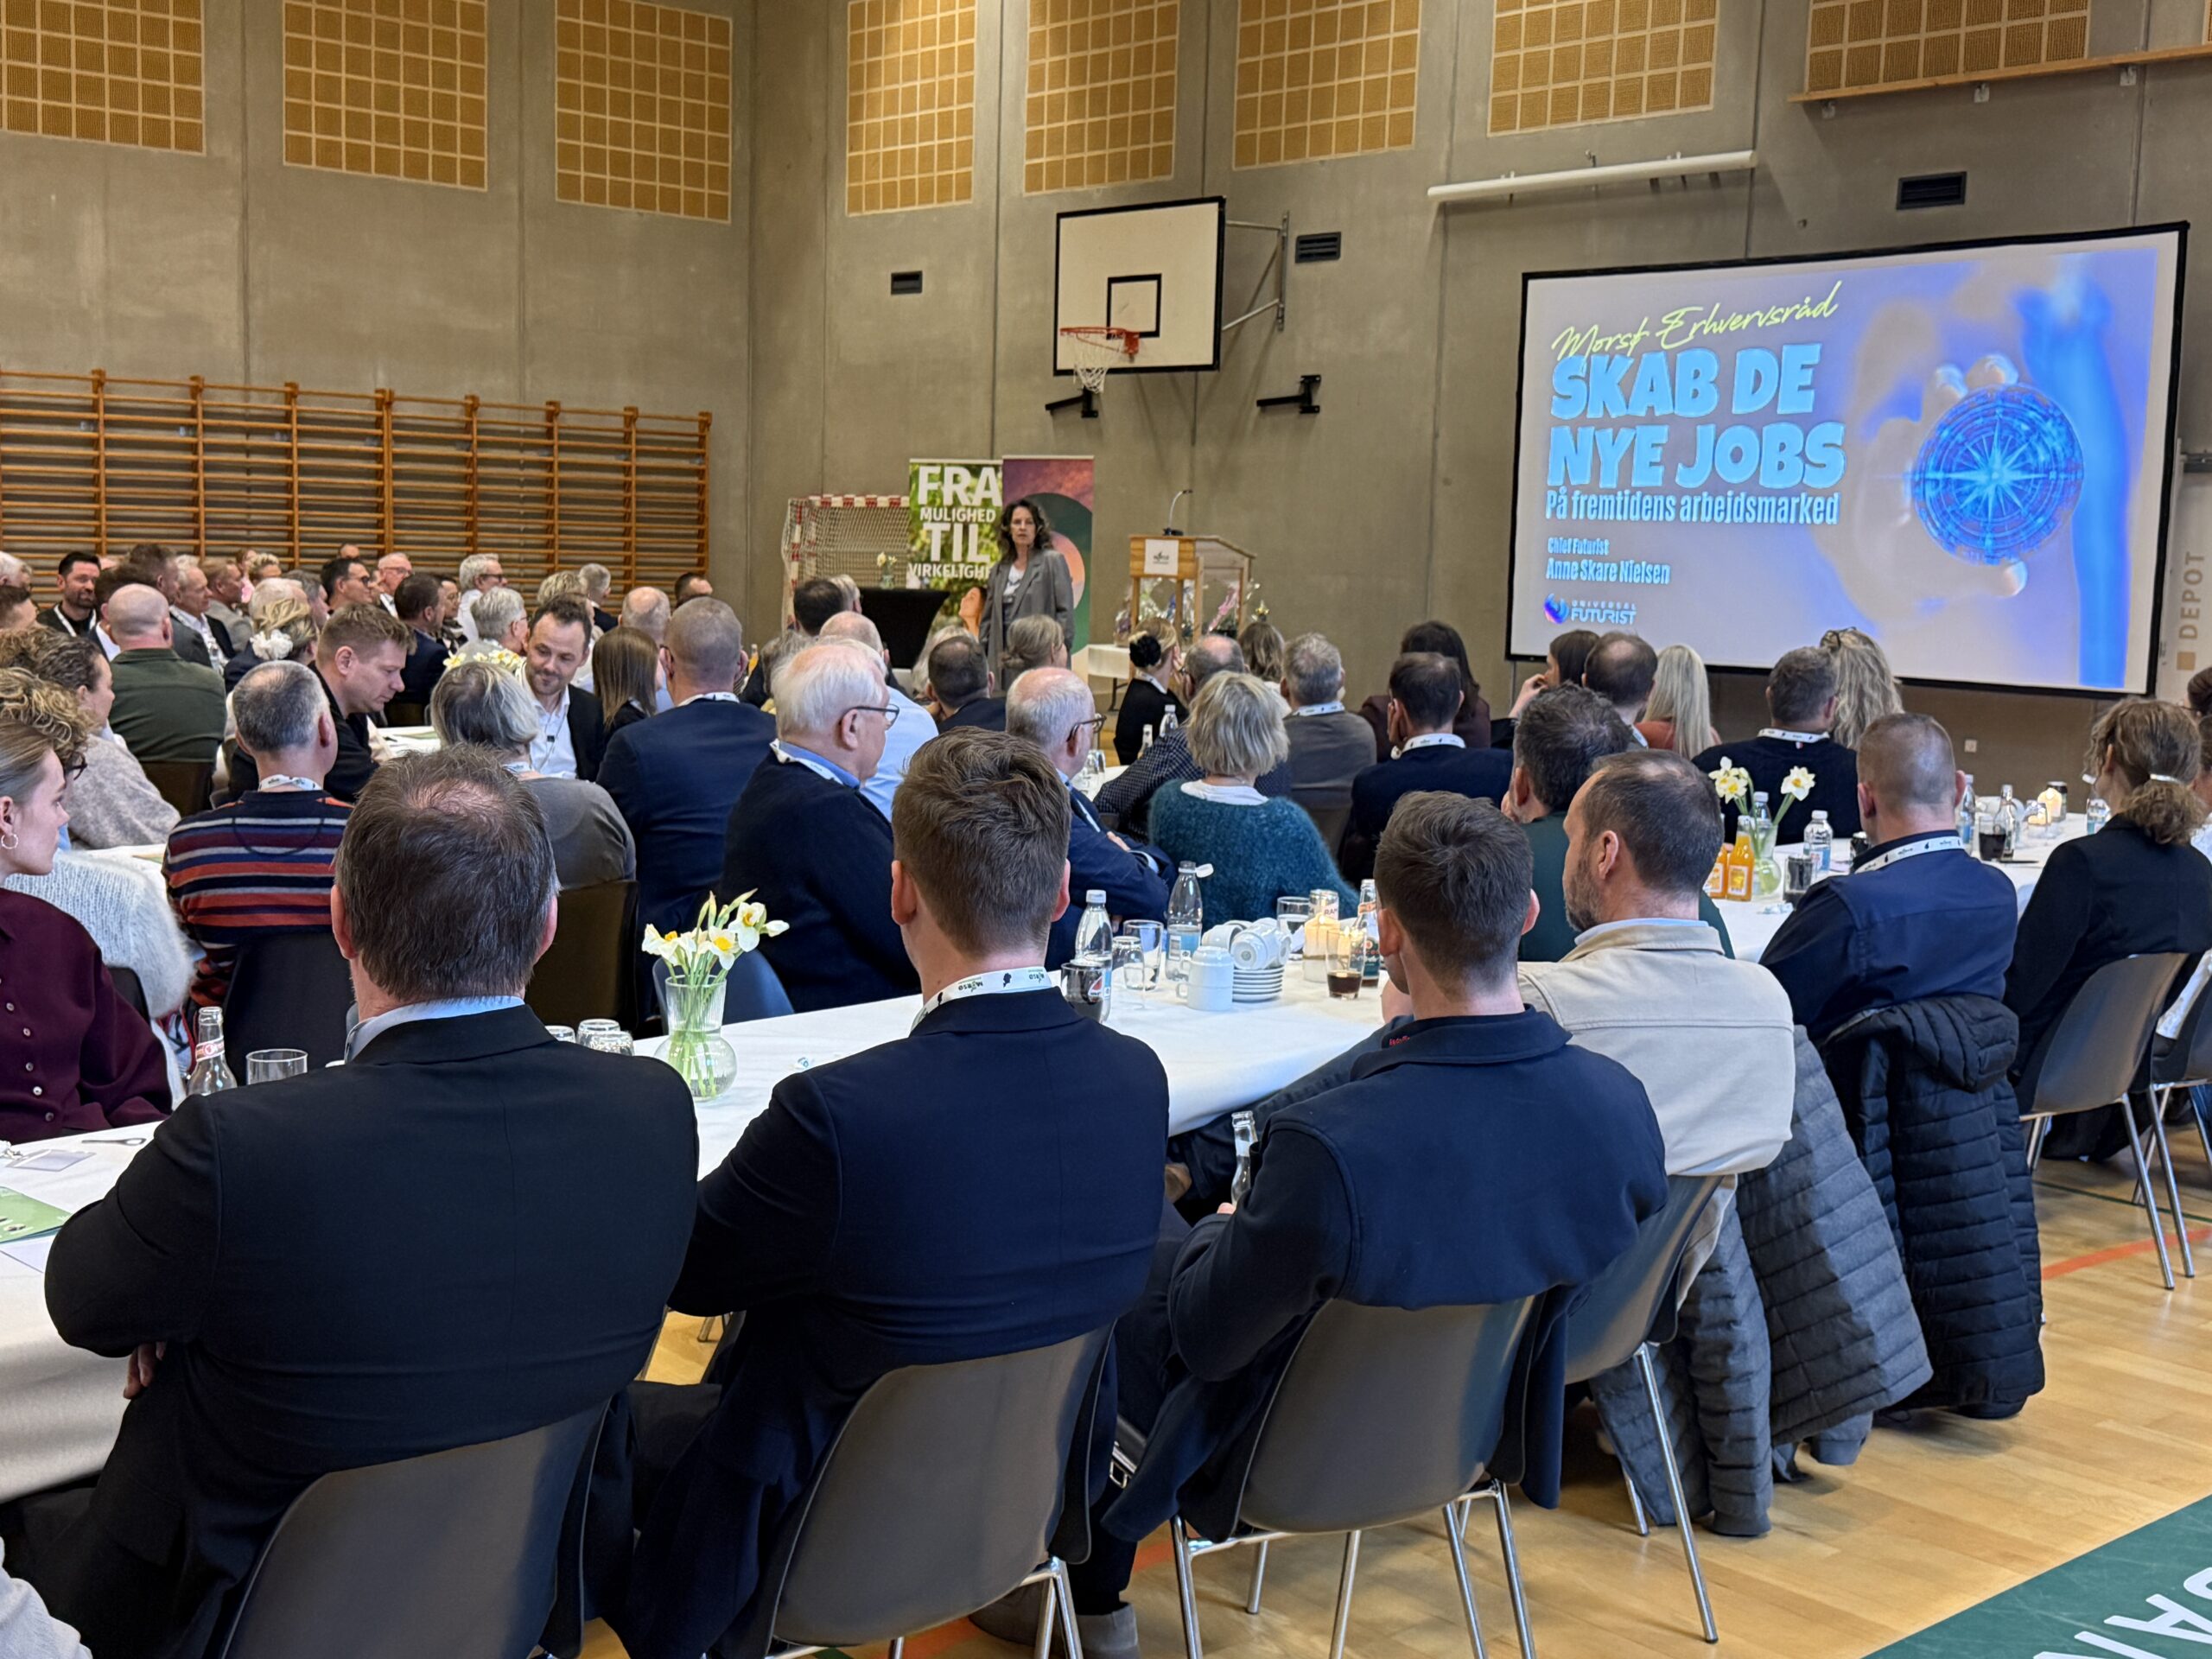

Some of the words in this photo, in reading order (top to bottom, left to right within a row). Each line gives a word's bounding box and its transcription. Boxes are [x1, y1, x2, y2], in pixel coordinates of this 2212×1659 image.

[1656, 281, 1843, 349] Erhvervsråd
[1551, 347, 1719, 420] SKAB
[1732, 343, 1822, 415] DE
[1547, 424, 1669, 489] NYE
[1675, 422, 1847, 489] JOBS
[918, 466, 1002, 506] FRA
[1546, 486, 1568, 519] På
[1572, 489, 1676, 521] fremtidens
[1680, 490, 1841, 524] arbejdsmarked
[919, 507, 996, 523] MULIGHED
[923, 522, 991, 563] TIL
[1548, 537, 1573, 554] Chief
[1573, 537, 1610, 556] Futurist
[1546, 557, 1580, 581] Anne
[1580, 558, 1618, 582] Skare
[1619, 559, 1671, 584] Nielsen
[2178, 551, 2205, 639] DEPOT
[1571, 607, 1637, 625] FUTURIST
